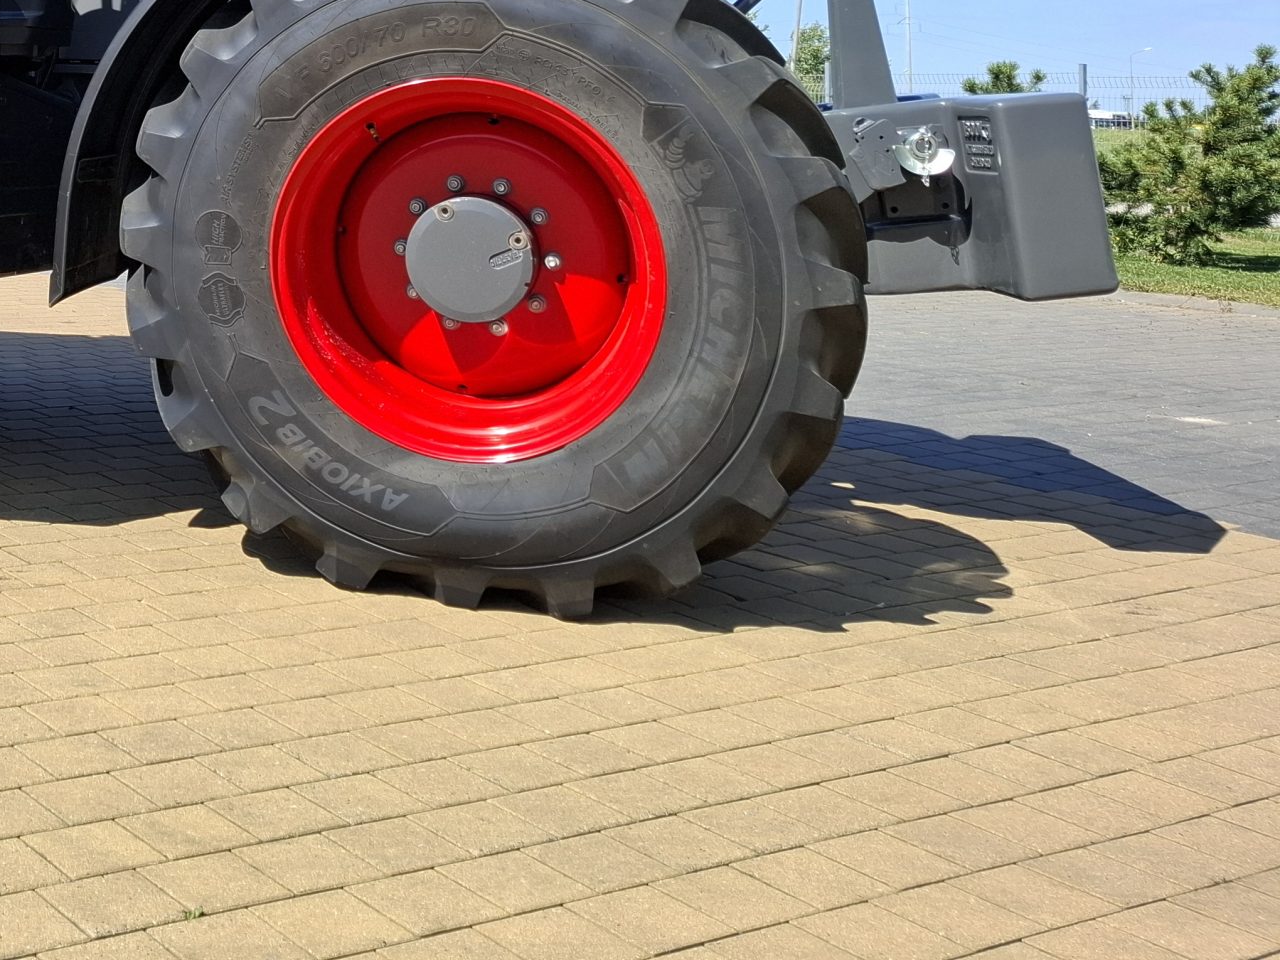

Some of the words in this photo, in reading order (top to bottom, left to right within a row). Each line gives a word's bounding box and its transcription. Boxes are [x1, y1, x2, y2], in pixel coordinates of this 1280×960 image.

[422, 15, 477, 39] R30
[211, 219, 221, 246] HIGH
[248, 390, 297, 426] 2
[276, 423, 410, 511] AXIOBIB
